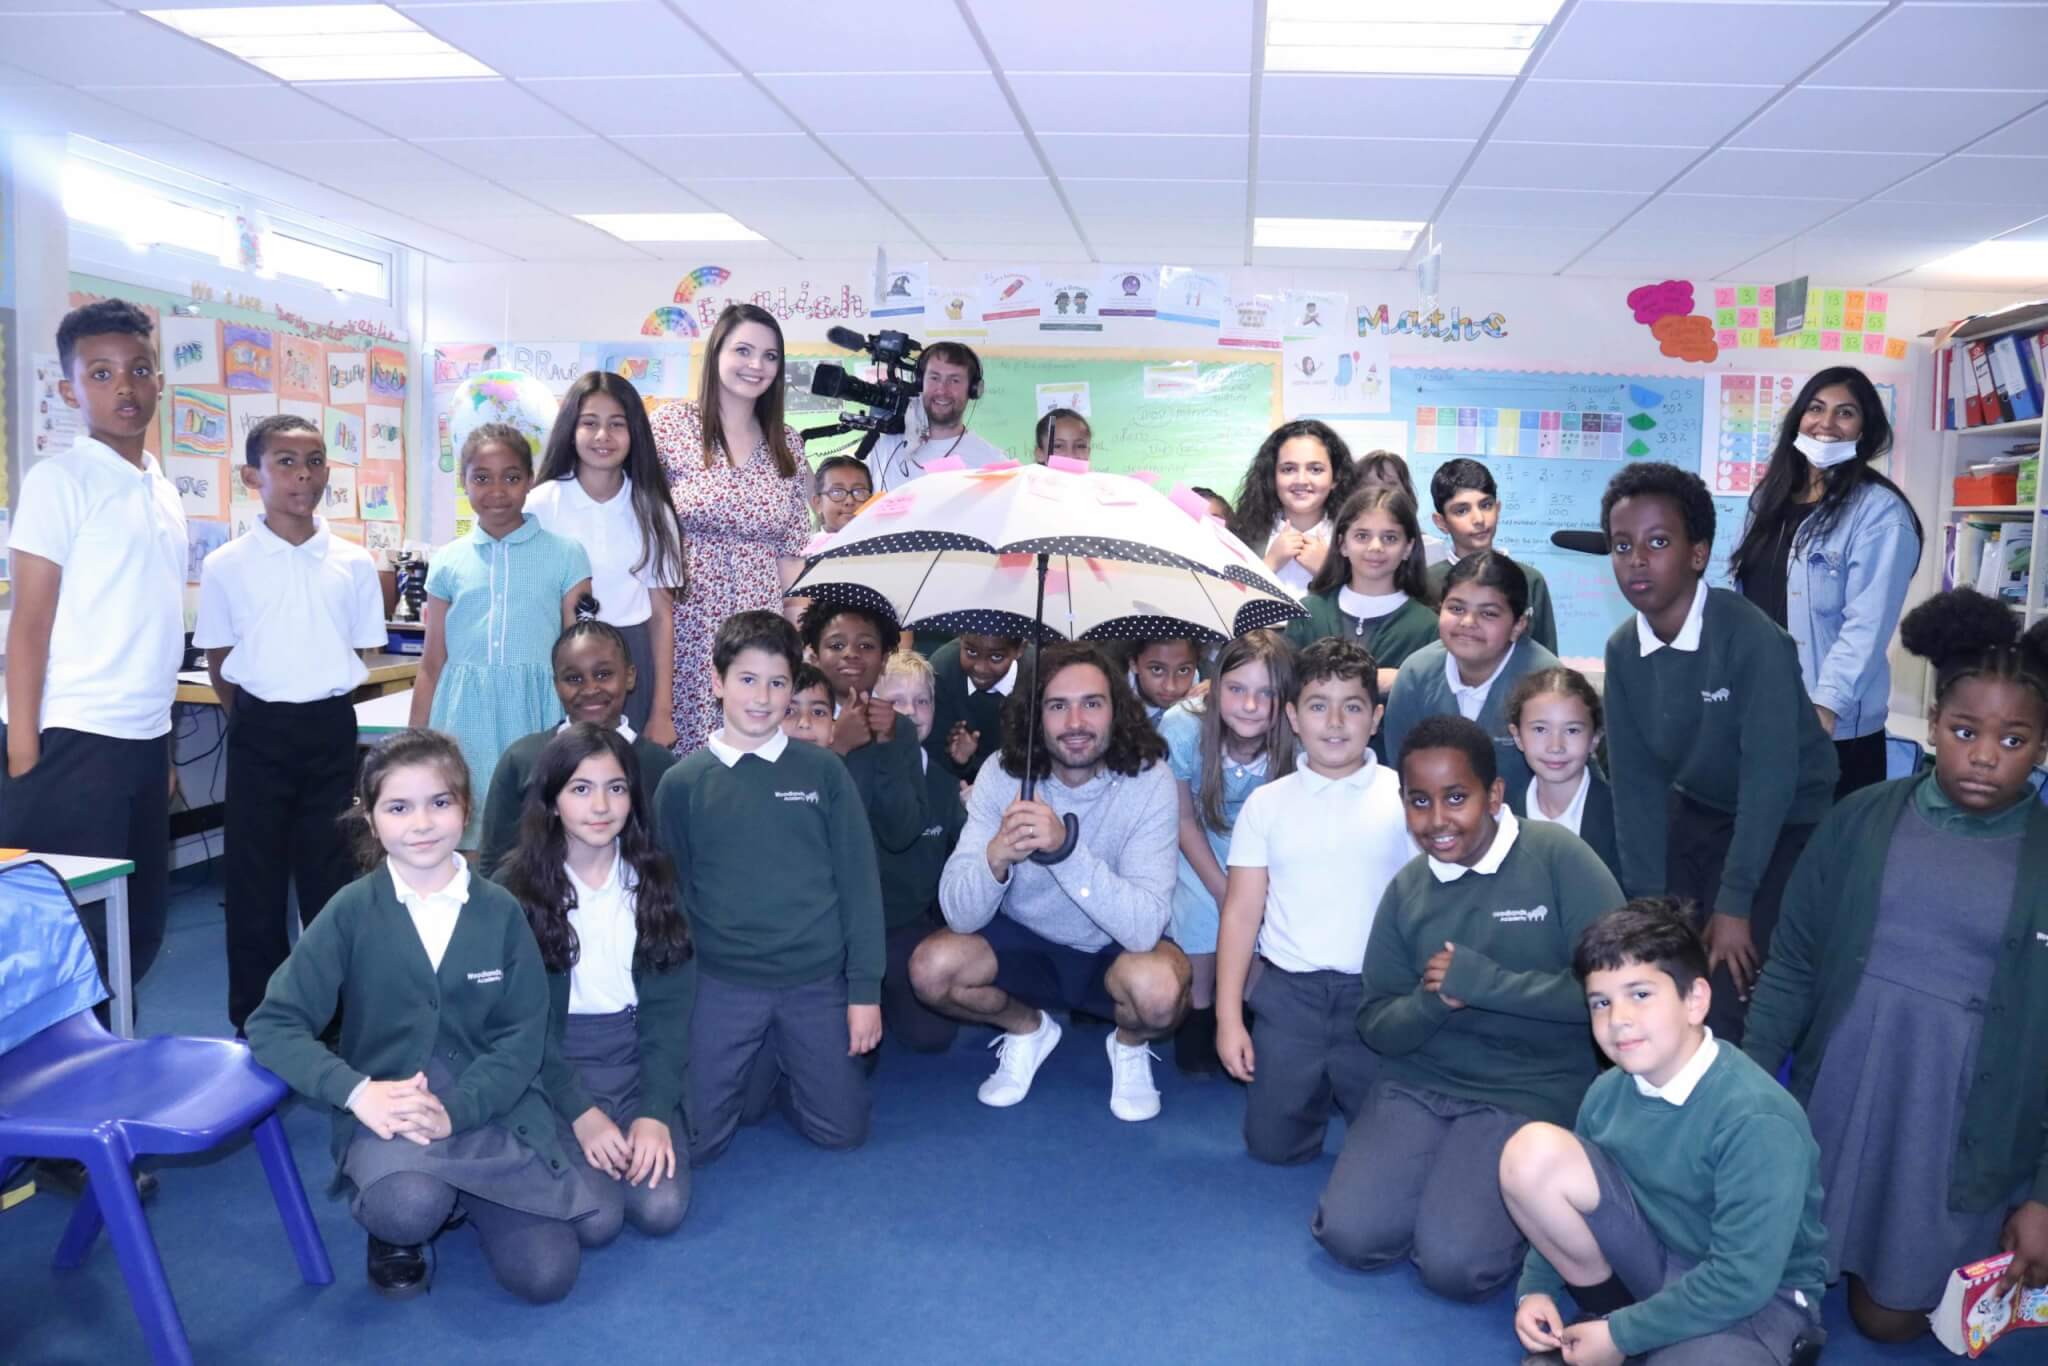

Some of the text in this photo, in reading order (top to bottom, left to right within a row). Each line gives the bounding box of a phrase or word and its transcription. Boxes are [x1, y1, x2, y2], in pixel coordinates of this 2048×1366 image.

[1828, 294, 1840, 306] 13
[1720, 312, 1735, 325] 23
[1826, 316, 1841, 328] 43
